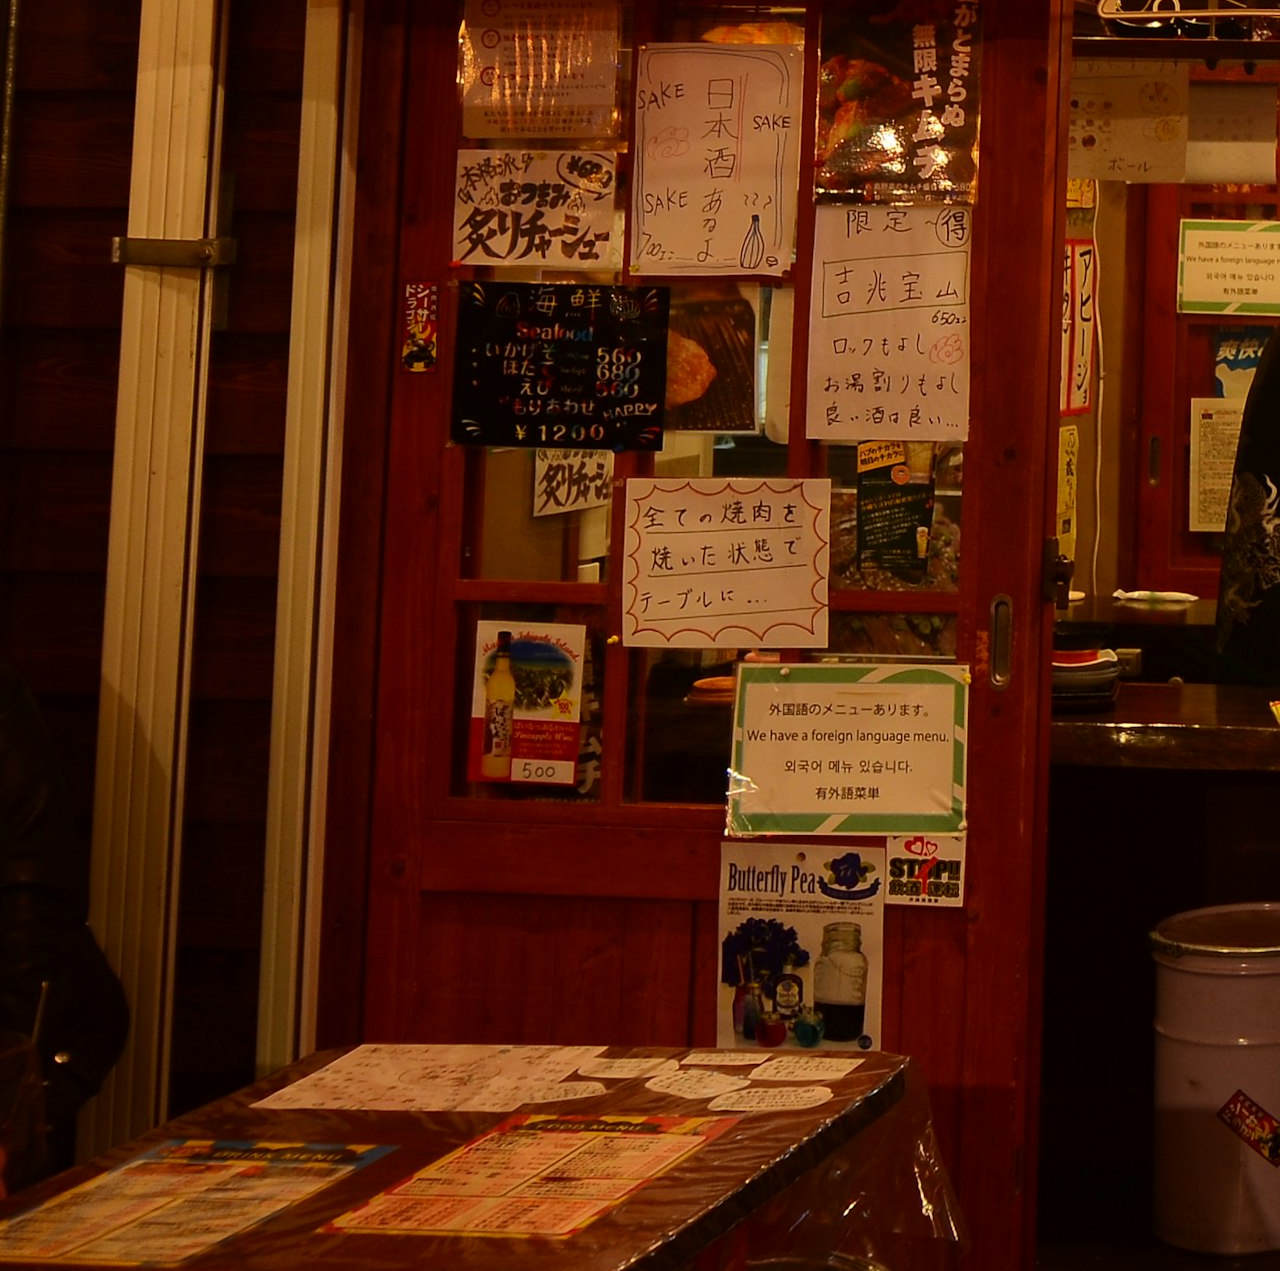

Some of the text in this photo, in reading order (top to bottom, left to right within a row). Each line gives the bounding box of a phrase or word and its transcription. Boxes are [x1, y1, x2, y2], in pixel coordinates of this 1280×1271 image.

[638, 81, 686, 112] SAKE
[753, 114, 791, 133] SAKE
[500, 179, 570, 210] おつまみ
[644, 186, 689, 216] SAKE
[458, 206, 610, 261] 炙りチャーシュー
[846, 209, 912, 239] 限定
[1220, 256, 1244, 265] foreign
[1245, 257, 1276, 266] language
[835, 269, 959, 306] 吉兆宝山
[528, 288, 602, 317] 海鮮
[516, 321, 594, 342] Seafood
[1077, 248, 1092, 405] アヒージョ
[485, 342, 642, 365] いかげそ 560
[833, 336, 926, 357] ロックもよし
[1216, 337, 1270, 361] 爽快
[503, 359, 554, 376] ほたて
[596, 363, 641, 381] 680
[824, 367, 959, 396] お湯割りもよし
[520, 378, 552, 397] えび
[512, 399, 597, 417] もりあわせ
[602, 402, 658, 422] HAPPY
[642, 500, 798, 530] 全ての焼肉を
[650, 536, 802, 572] 焼いた状態で
[769, 702, 930, 717] 外国語のメニューあります。
[747, 729, 950, 745] We have a foreign language menu.
[522, 762, 556, 779] 500
[784, 759, 913, 775] 외국어 메뉴 있습니다.
[728, 862, 817, 899] Butterfly Pea
